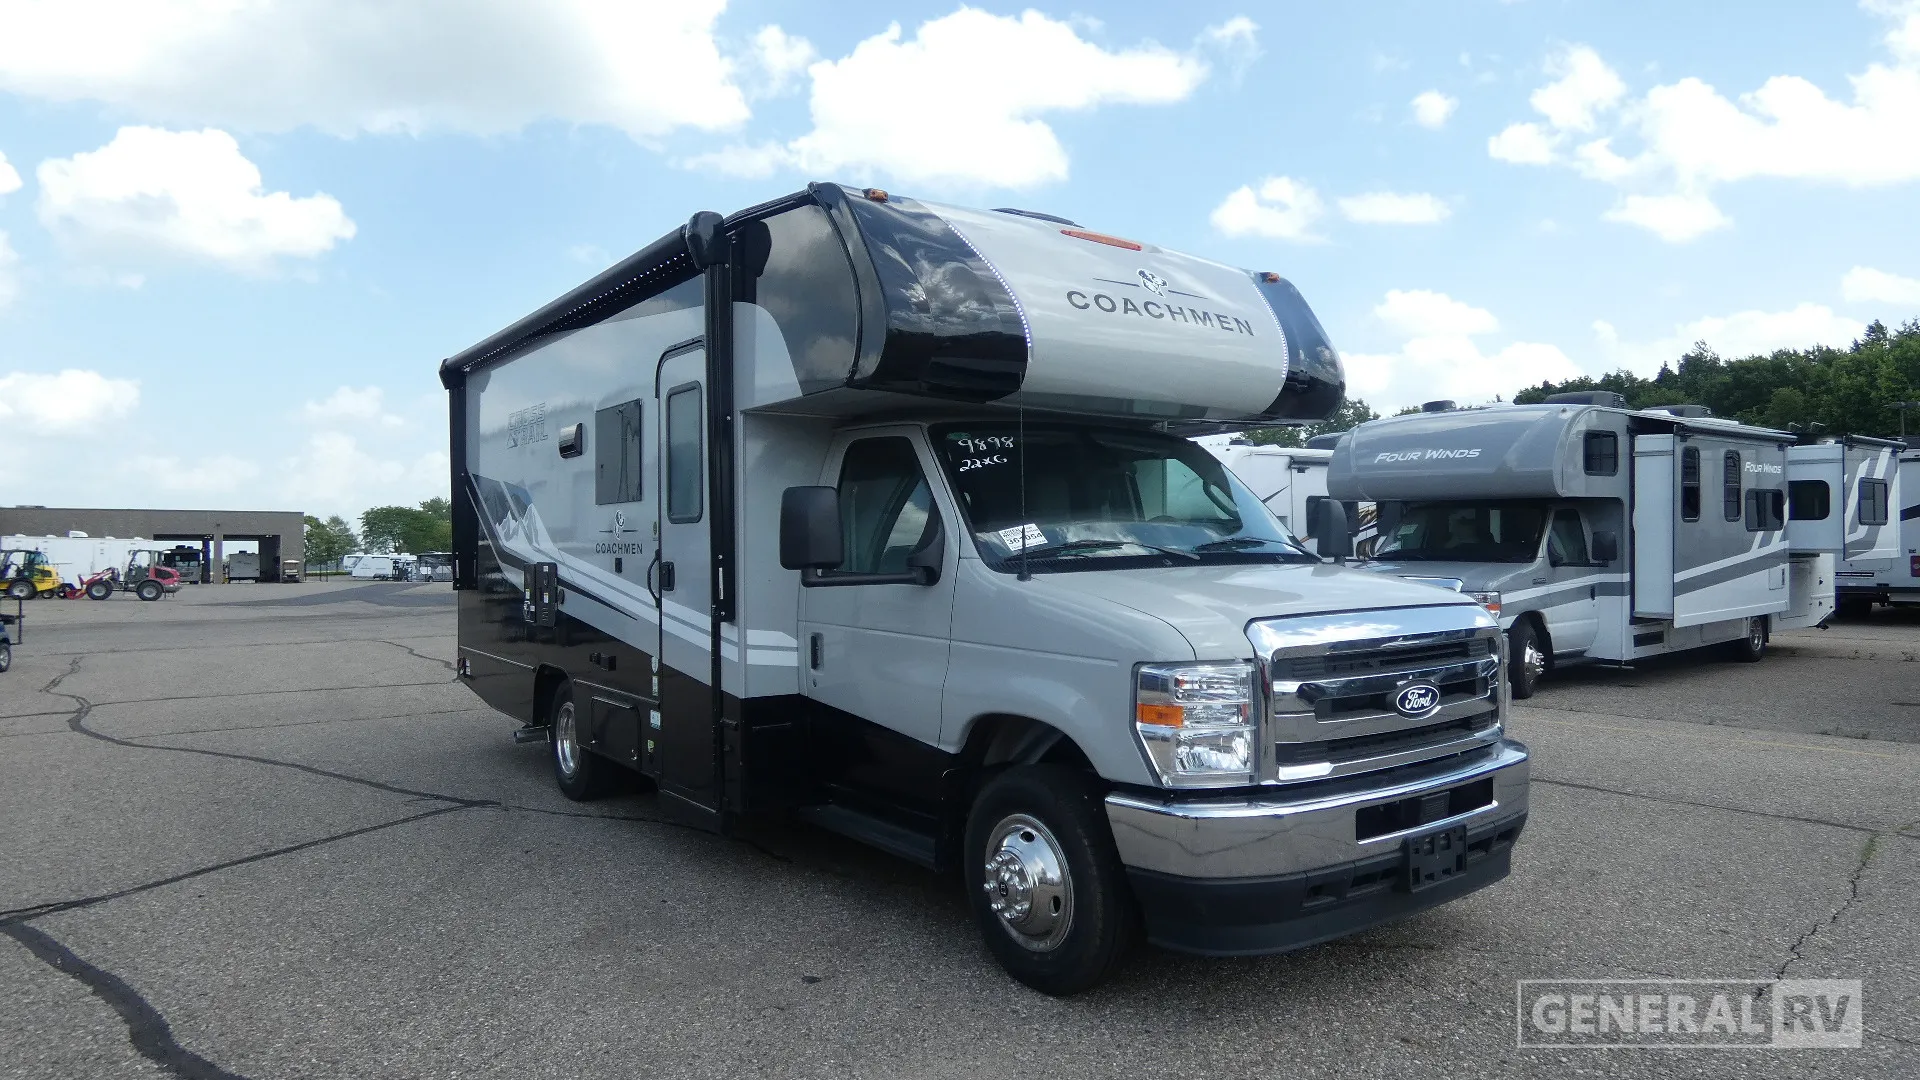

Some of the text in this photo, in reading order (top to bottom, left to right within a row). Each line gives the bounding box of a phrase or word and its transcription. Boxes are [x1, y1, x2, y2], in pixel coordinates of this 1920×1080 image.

[1066, 290, 1255, 337] COACHMEN
[508, 402, 546, 430] CROSS
[957, 436, 1014, 453] 9898
[1374, 448, 1482, 464] FOUR WINDS
[1744, 461, 1763, 473] FOUR
[595, 542, 643, 555] COACHMEN
[1405, 689, 1432, 709] Ford
